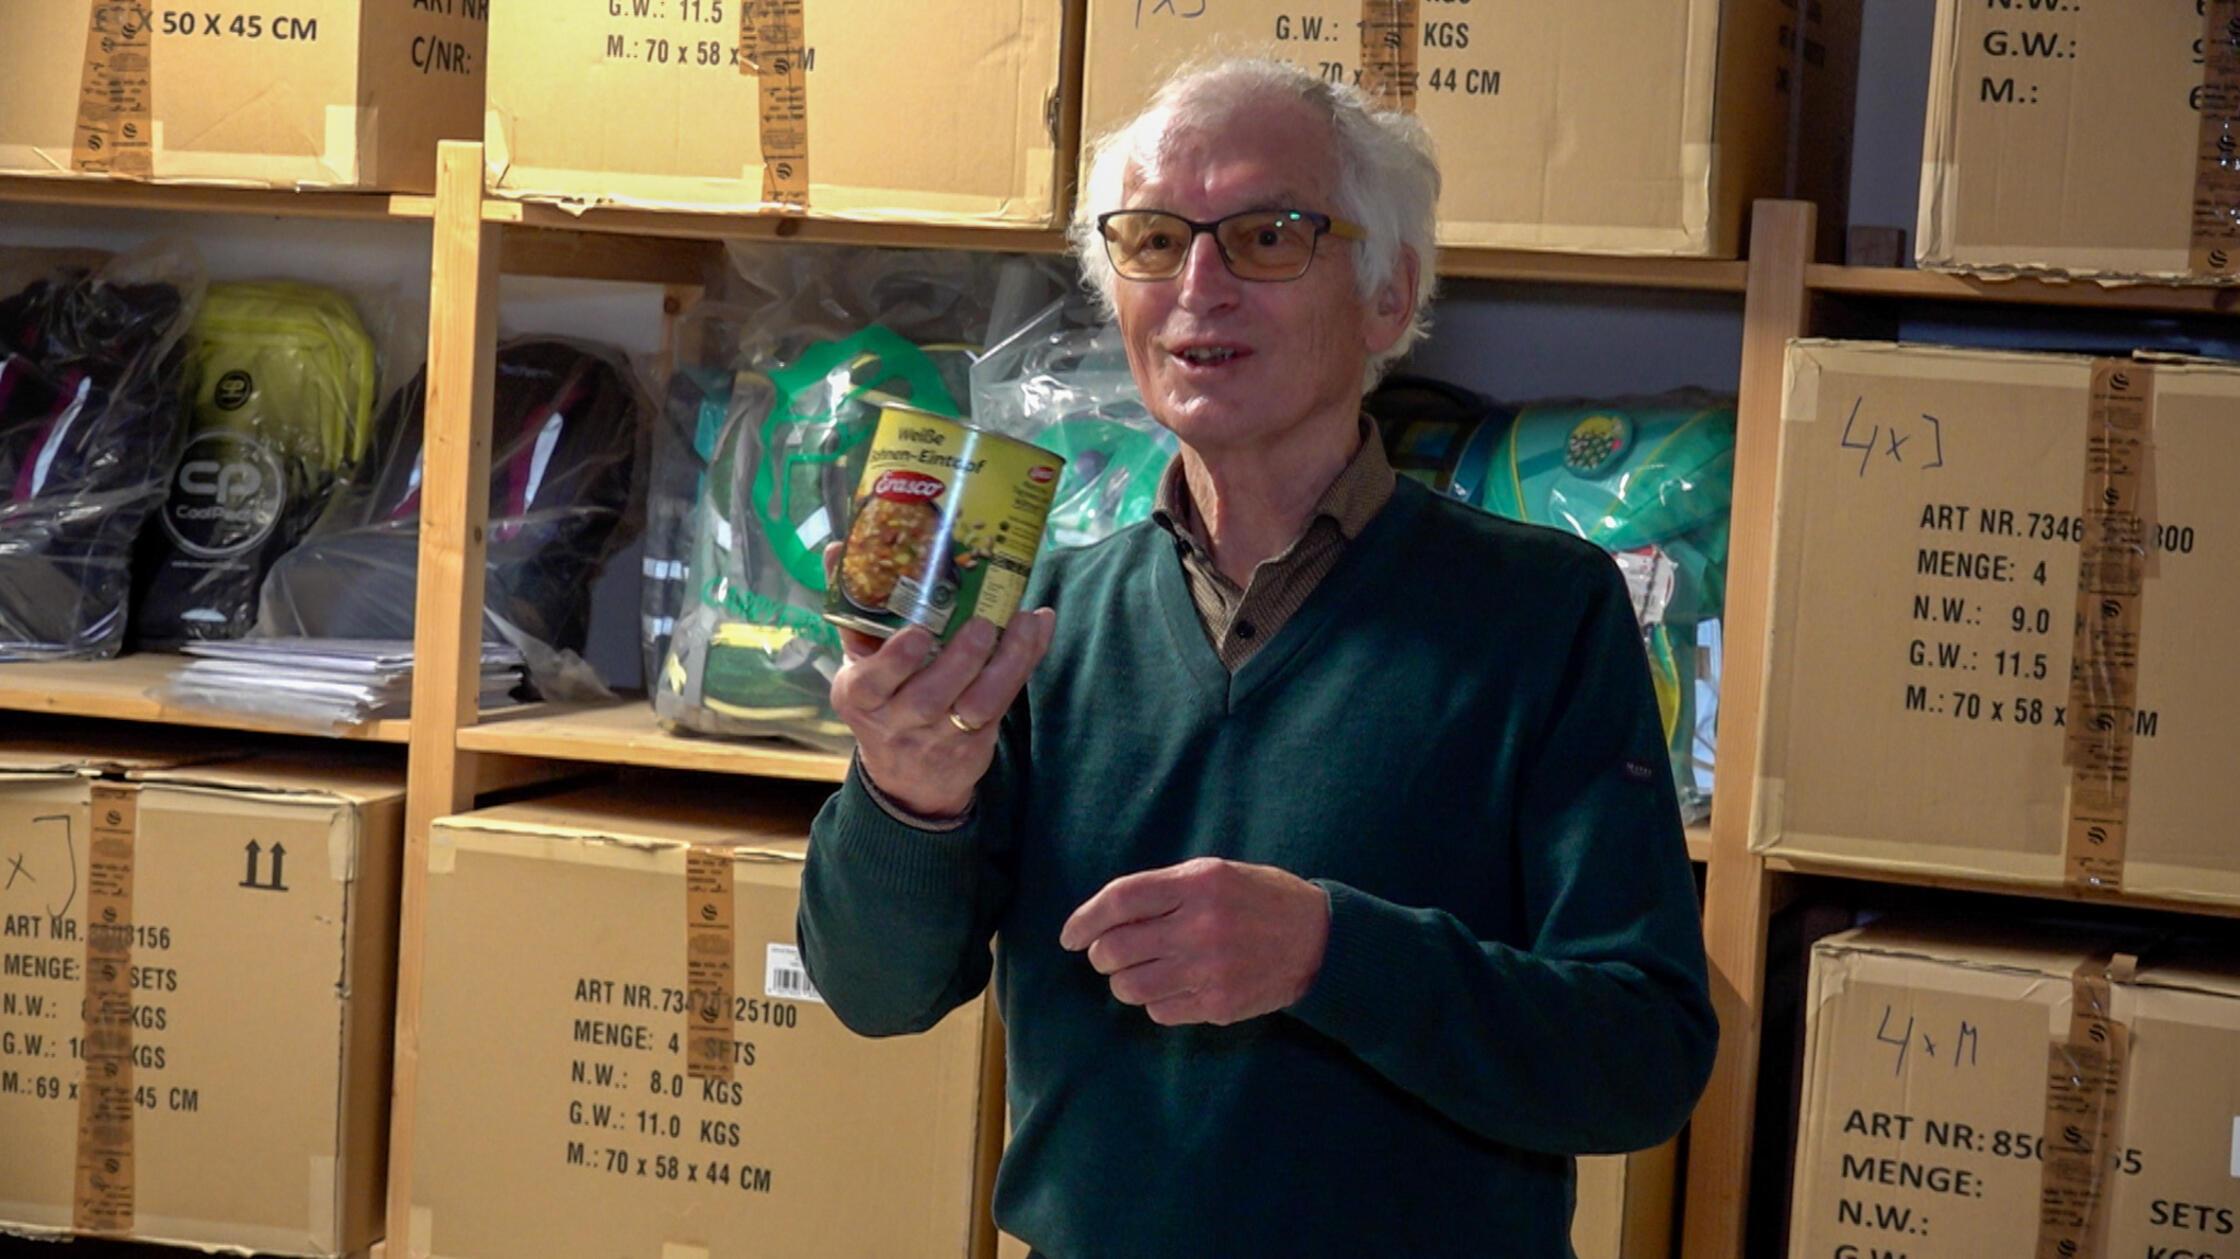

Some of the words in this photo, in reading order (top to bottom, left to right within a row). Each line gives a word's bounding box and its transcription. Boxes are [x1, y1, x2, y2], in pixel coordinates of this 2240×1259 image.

[163, 11, 195, 35] 50
[203, 13, 221, 36] X
[229, 15, 262, 38] 45
[271, 16, 317, 41] CM
[681, 0, 723, 24] 11.5
[1275, 14, 1339, 42] G.W.:
[1423, 21, 1470, 49] KGS
[1983, 30, 2076, 59] G.W.:
[412, 35, 471, 75] C/NR:
[645, 38, 669, 64] 70
[678, 45, 688, 65] x
[696, 41, 720, 66] 58
[1429, 67, 1457, 92] 44
[1465, 68, 1501, 96] CM
[1980, 77, 2038, 104] M.:
[1920, 503, 1970, 532] ART
[1917, 549, 2015, 582] MENGE:
[2033, 560, 2047, 586] 4
[1913, 595, 1982, 626] N.W.:
[2011, 605, 2050, 634] 9.0
[1909, 639, 1978, 671] G.W.:
[1995, 650, 2048, 680] 11.5
[1952, 692, 1981, 720] 70
[1991, 701, 2004, 722] x
[2014, 697, 2043, 726] 58
[2053, 706, 2066, 727] x
[4, 914, 43, 938] ART
[3, 953, 81, 981] MENGE:
[129, 966, 178, 992] SETS
[2, 992, 57, 1019] N.W.:
[574, 978, 615, 1004] ART
[2, 1031, 56, 1059] G.W.:
[573, 1019, 654, 1051] MENGE:
[668, 1032, 679, 1054] 4
[36, 1076, 60, 1100] 69
[134, 1086, 157, 1109] 45
[169, 1087, 199, 1112] CM
[571, 1060, 628, 1090] N.W.:
[650, 1070, 683, 1098] 8.0
[703, 1078, 743, 1106] KGS
[569, 1100, 625, 1131] G.W.:
[637, 1110, 681, 1139] 11.0
[700, 1119, 741, 1147] KGS
[1843, 1109, 1914, 1140] ART
[605, 1148, 628, 1174] 70
[636, 1158, 647, 1177] x
[655, 1155, 679, 1181] 58
[687, 1163, 698, 1183] x
[706, 1161, 730, 1186] 44
[740, 1165, 772, 1193] CM
[1840, 1154, 1983, 1198] MENGE:
[2148, 1199, 2235, 1235] SETS
[1837, 1199, 1929, 1236] N.W.:
